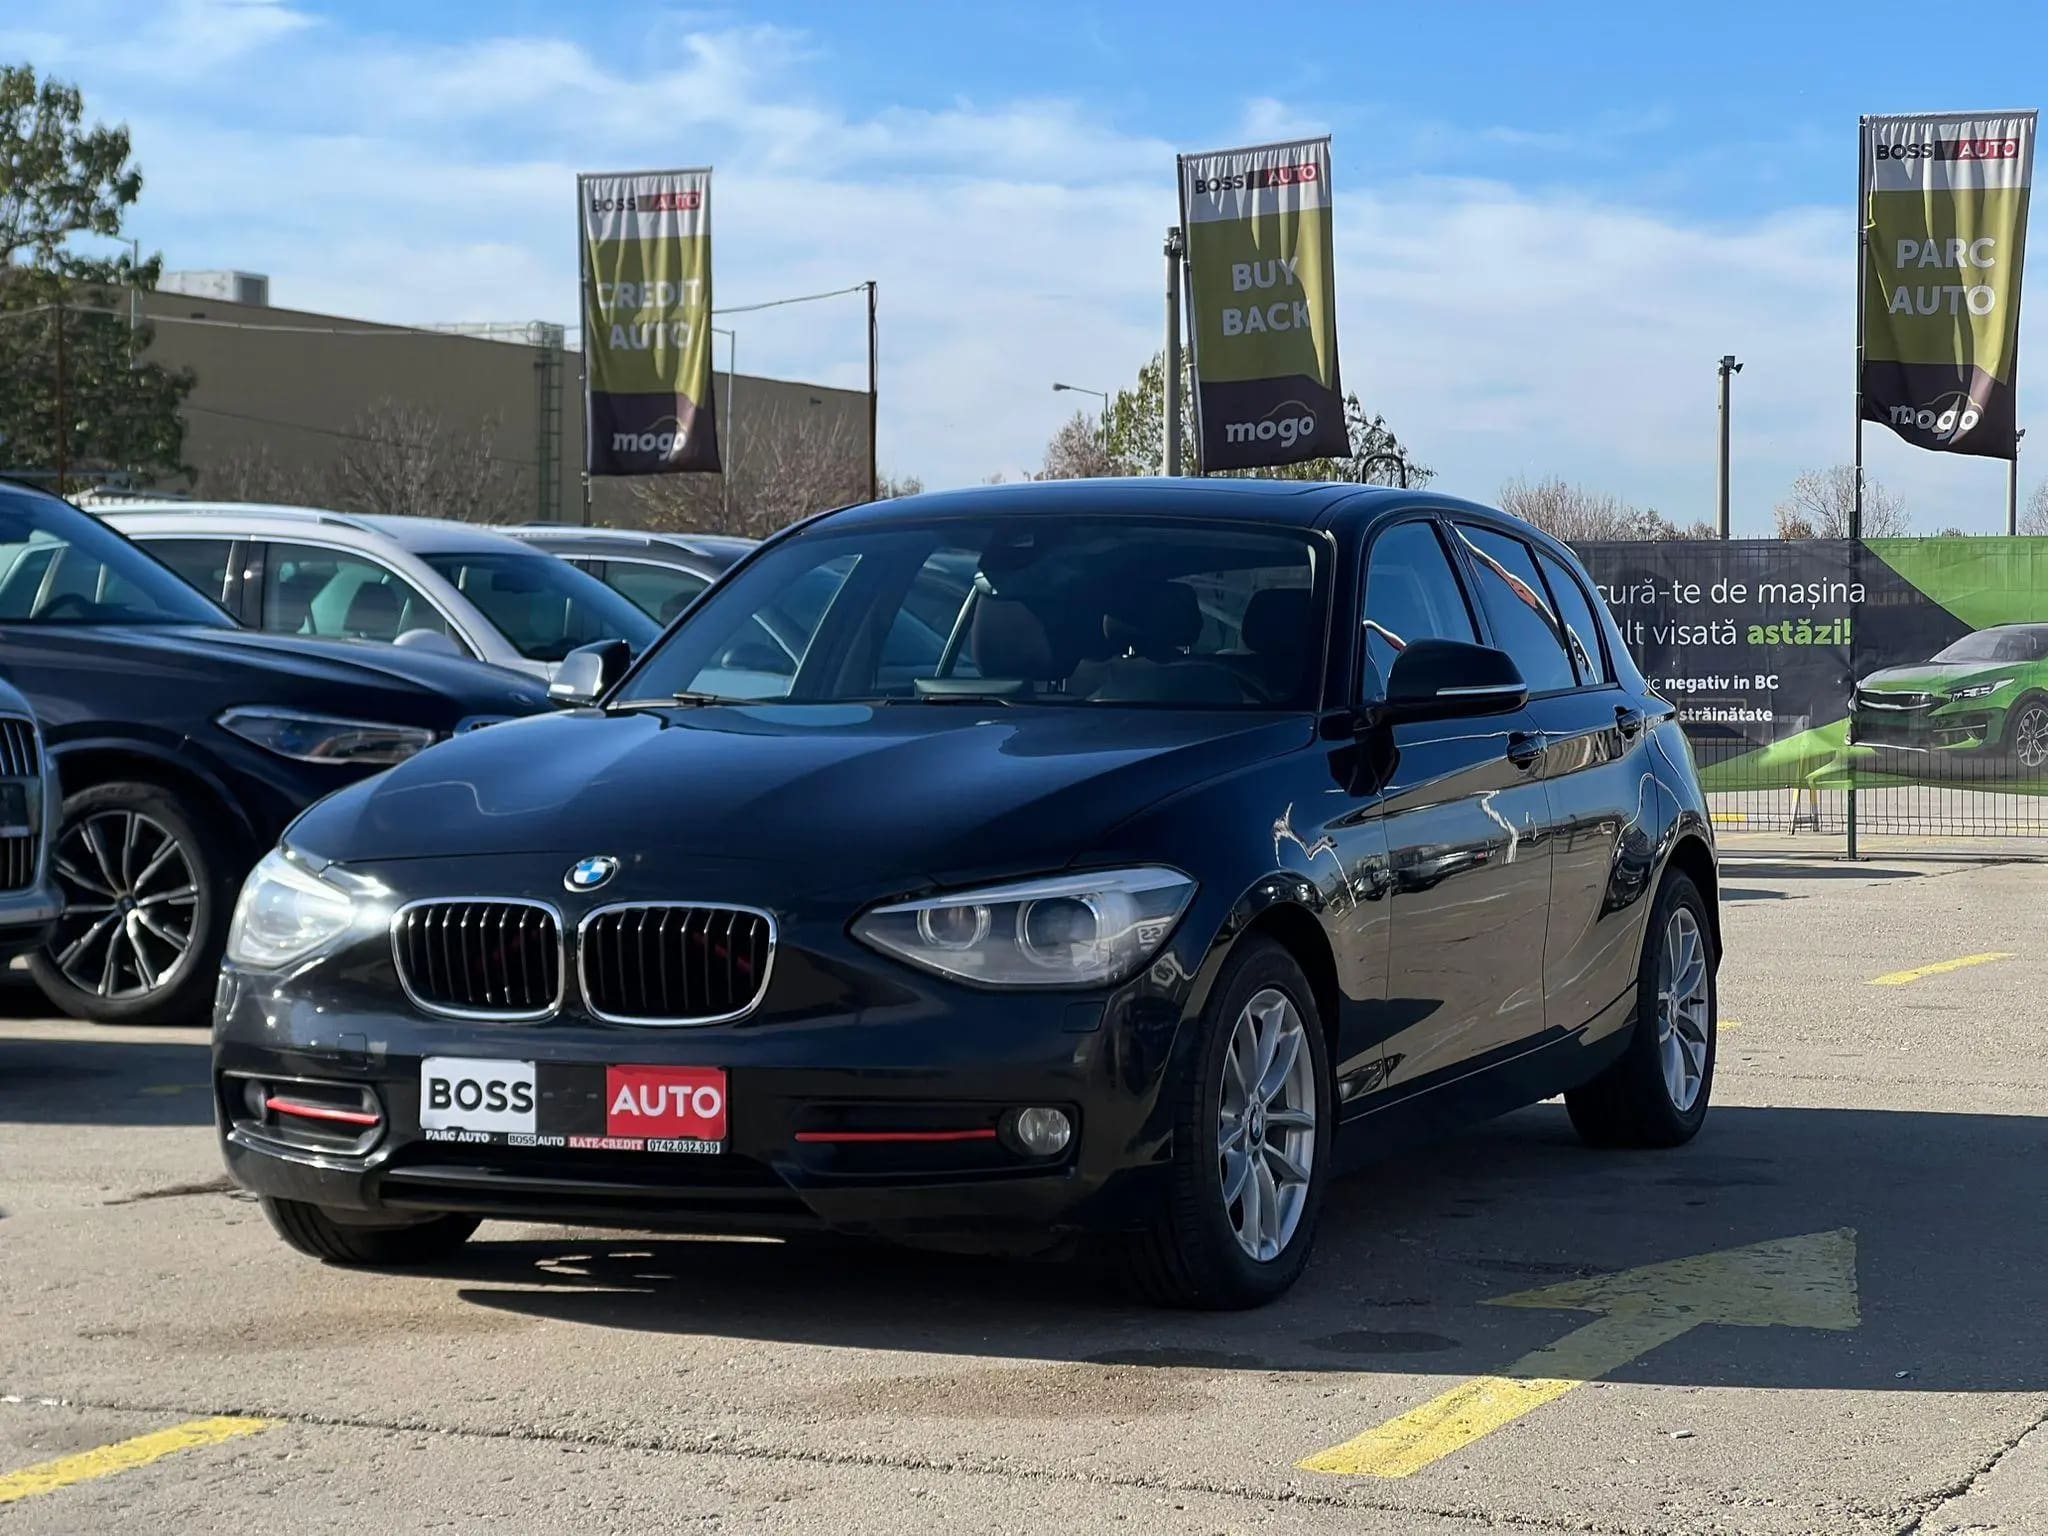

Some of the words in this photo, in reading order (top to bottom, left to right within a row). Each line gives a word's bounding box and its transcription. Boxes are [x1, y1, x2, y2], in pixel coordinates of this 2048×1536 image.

[1874, 141, 1933, 161] BOSS
[1958, 138, 2016, 159] AUTO
[1195, 174, 1244, 194] BOSS
[1267, 163, 1317, 186] AUTO
[592, 195, 636, 213] BOSS
[655, 191, 702, 211] AUTO
[1896, 237, 1996, 268] PARC
[1231, 256, 1298, 292] BUY
[597, 279, 702, 310] CREDIT
[1888, 286, 1996, 316] AUTO
[1221, 301, 1309, 337] BACK
[609, 324, 695, 351] AUTO
[1225, 415, 1315, 447] mogo
[1889, 405, 1980, 440] mogo
[612, 429, 688, 462] mogo
[1710, 577, 1748, 603] de
[1757, 576, 1866, 609] mașina
[1653, 618, 1738, 646] visată
[1747, 617, 1853, 646] astăzi!
[1665, 674, 1730, 693] negativ
[1733, 674, 1751, 690] in
[1754, 674, 1780, 691] BC
[1679, 707, 1774, 723] străinătate
[428, 1077, 535, 1114] BOSS
[610, 1083, 722, 1119] AUTO
[425, 1129, 456, 1141] PARC
[457, 1131, 490, 1143] AUTO
[510, 1134, 536, 1146] BOSS
[537, 1136, 565, 1147] AUTO
